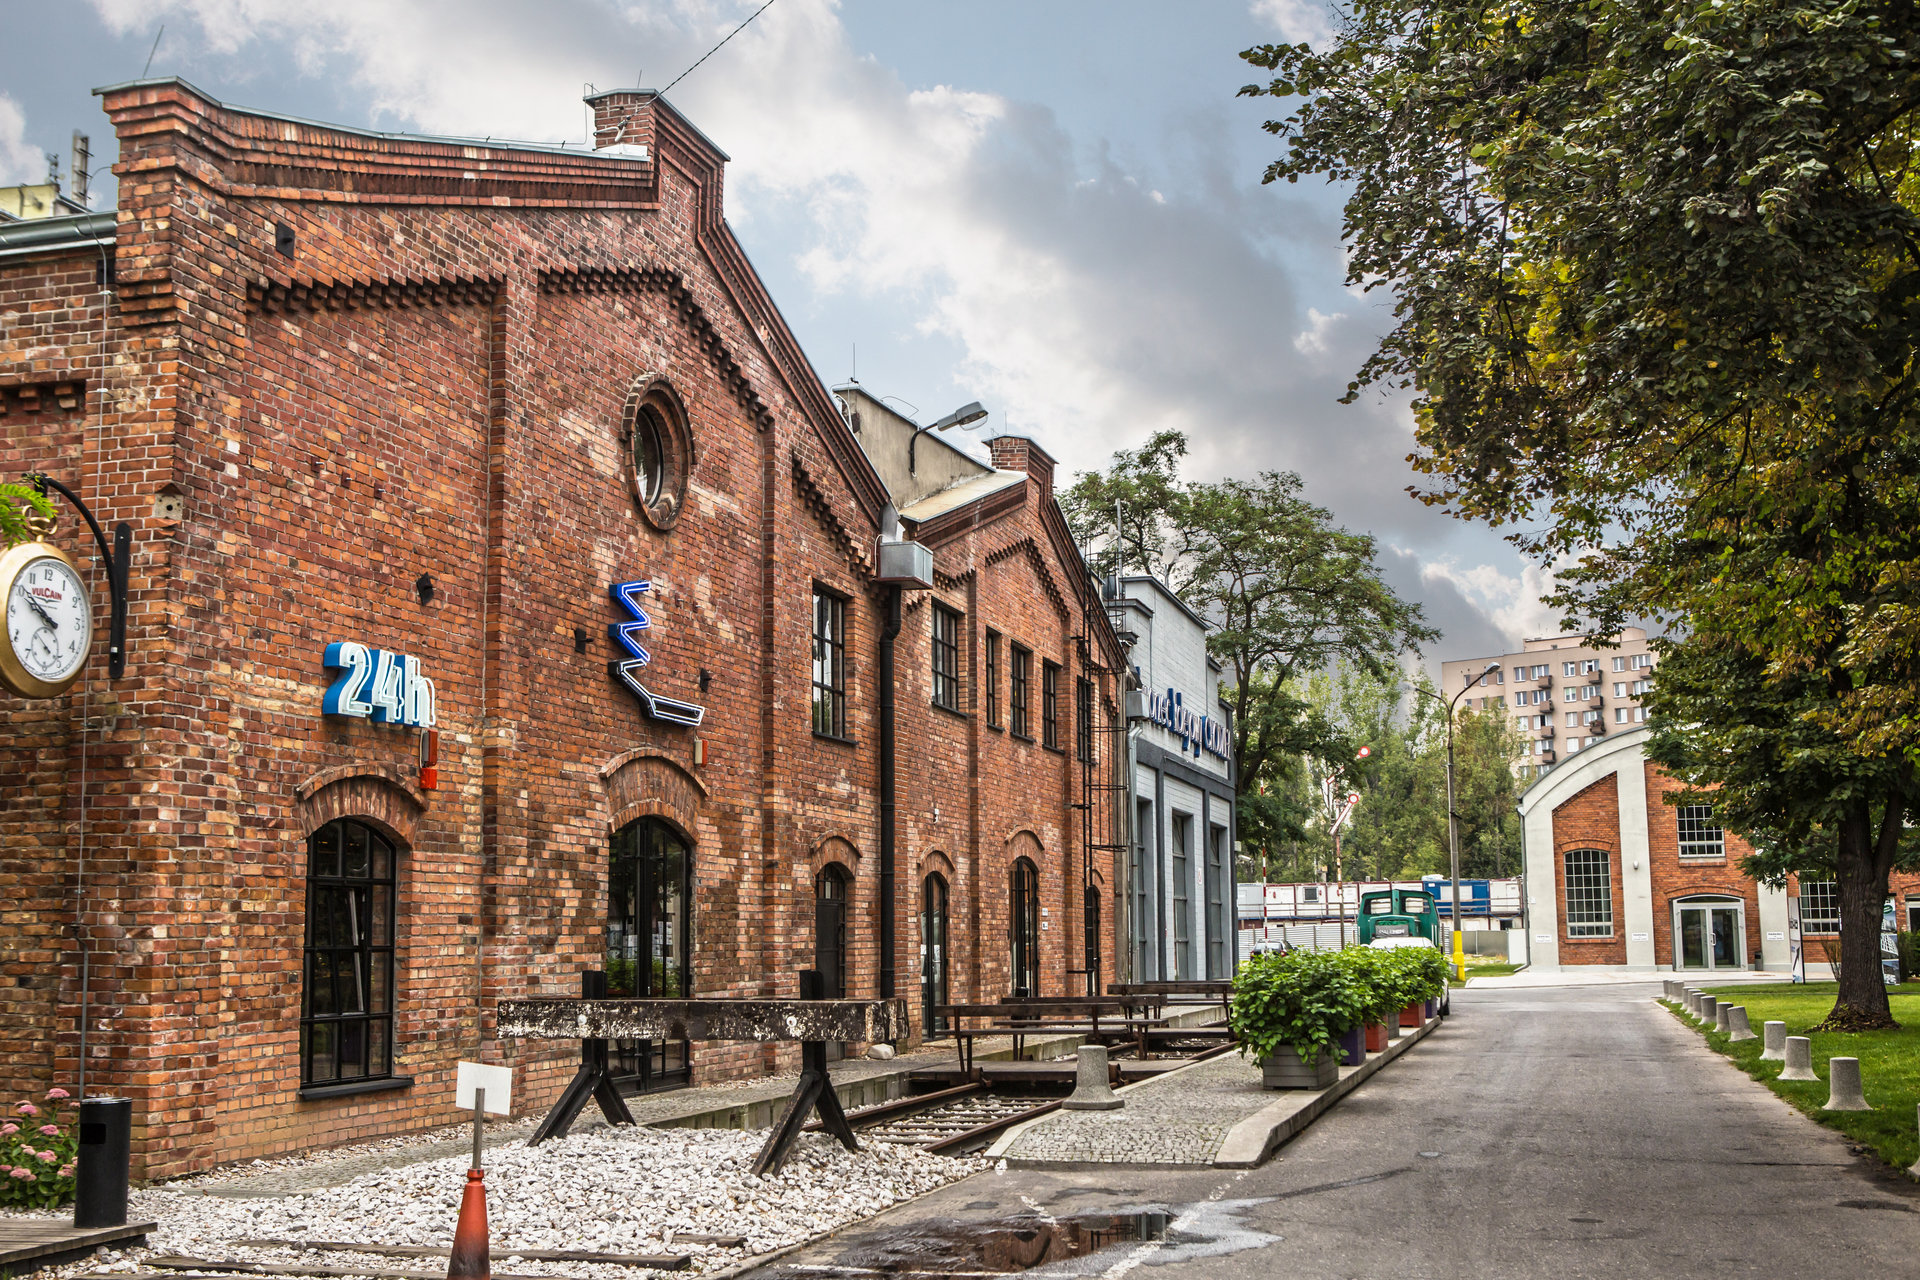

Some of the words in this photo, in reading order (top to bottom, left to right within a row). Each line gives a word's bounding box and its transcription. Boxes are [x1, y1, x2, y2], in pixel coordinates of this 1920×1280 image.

[29, 573, 36, 585] 11
[44, 569, 53, 581] 12
[31, 587, 62, 600] VULCAIN
[72, 597, 78, 608] 2
[74, 617, 81, 631] 3
[69, 640, 76, 653] 4
[25, 648, 31, 659] 7
[323, 641, 436, 728] 24h
